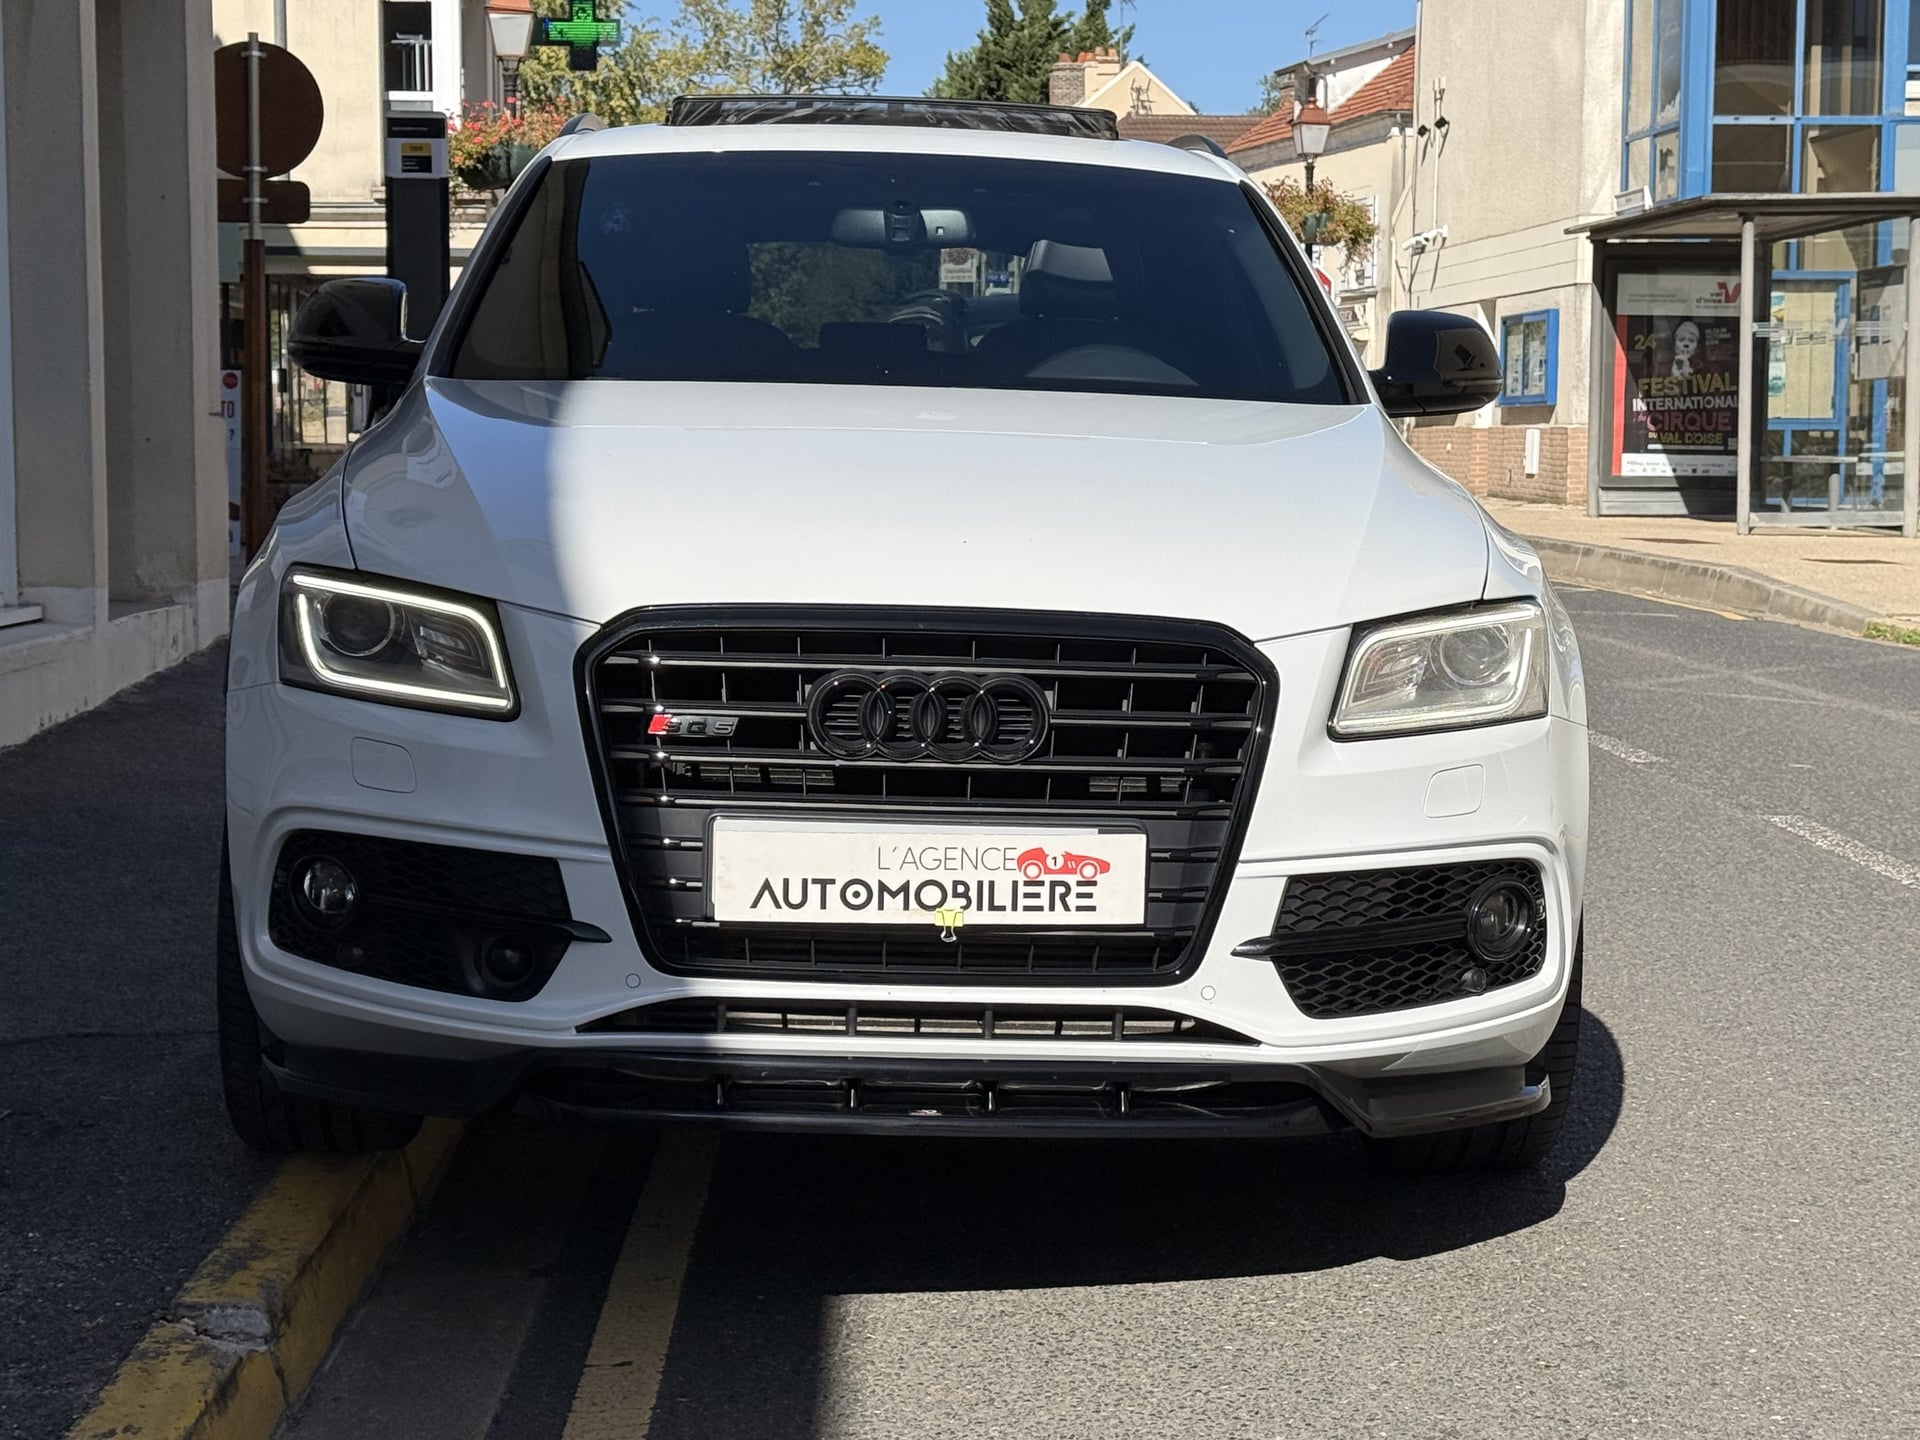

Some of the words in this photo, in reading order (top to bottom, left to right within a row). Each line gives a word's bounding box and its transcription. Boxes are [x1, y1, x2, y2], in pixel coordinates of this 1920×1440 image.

[1638, 372, 1737, 398] FESTIVAL
[1646, 412, 1731, 431] CIRQUE
[1660, 433, 1682, 444] VAL
[1685, 432, 1723, 445] D'OISE
[877, 845, 1017, 872] L'AGENCE
[1051, 856, 1058, 868] 1
